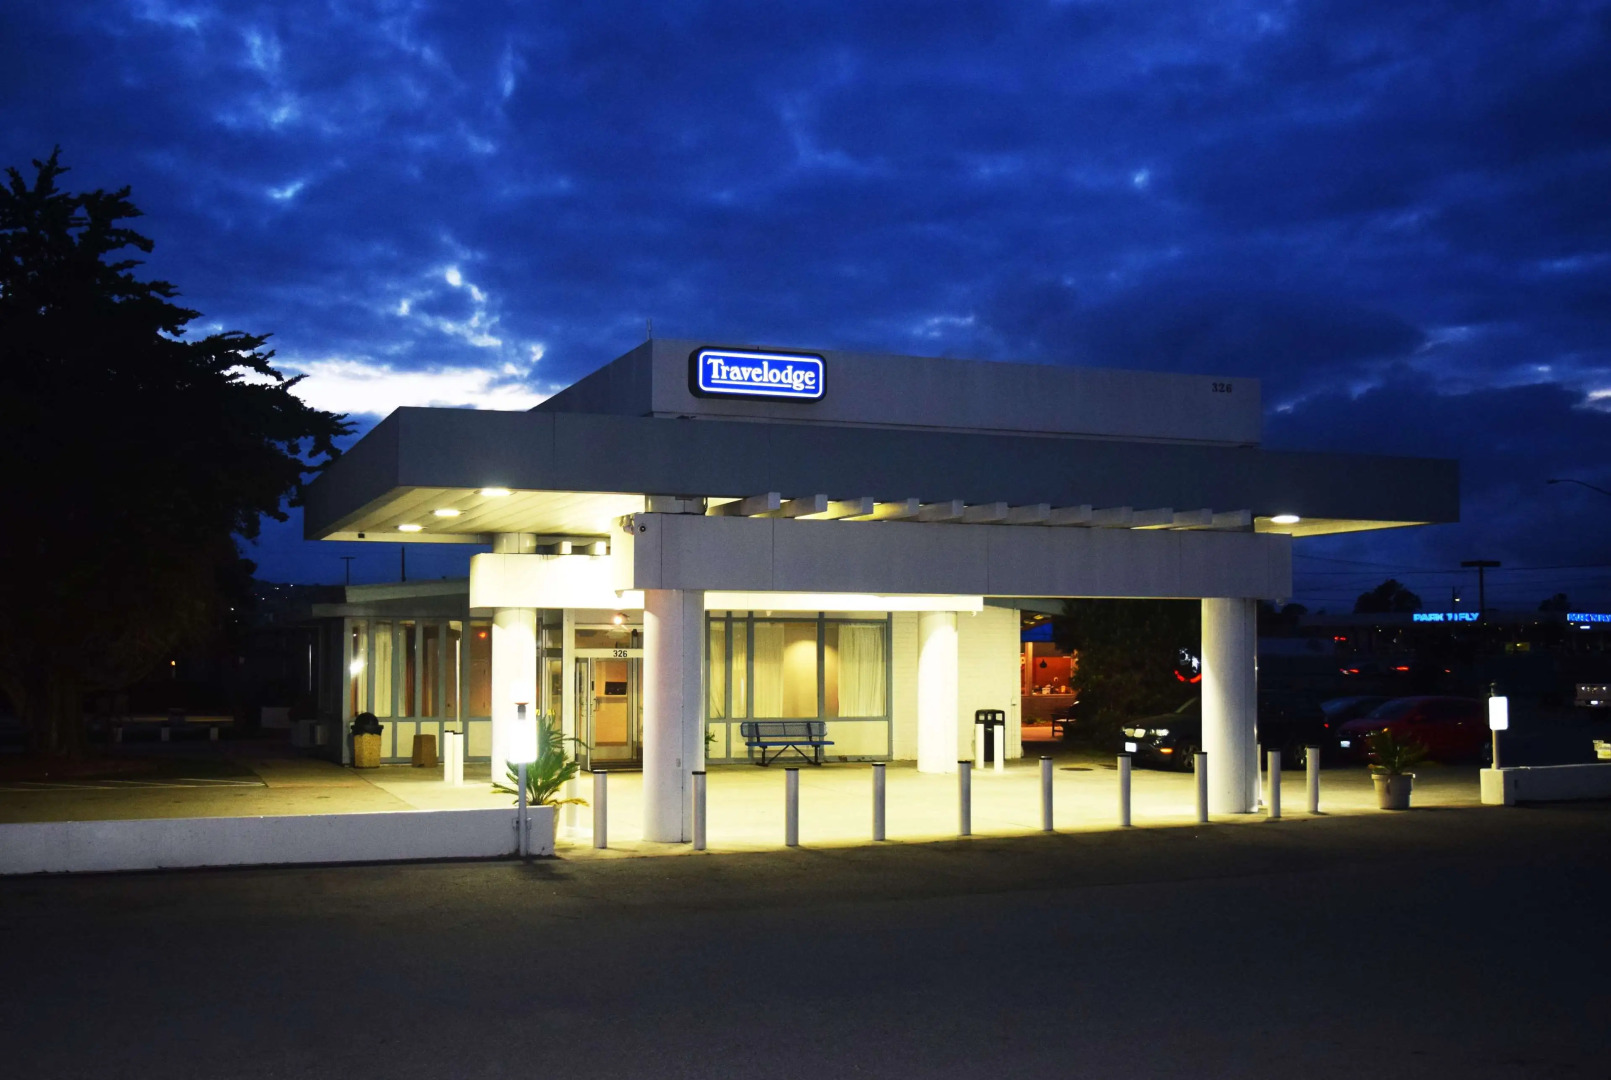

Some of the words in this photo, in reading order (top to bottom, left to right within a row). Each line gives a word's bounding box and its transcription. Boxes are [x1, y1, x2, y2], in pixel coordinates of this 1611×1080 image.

[707, 358, 816, 391] Travelodge
[1212, 382, 1232, 393] 326
[1413, 613, 1444, 622] PARK
[1459, 612, 1479, 621] FLY
[613, 649, 628, 658] 326
